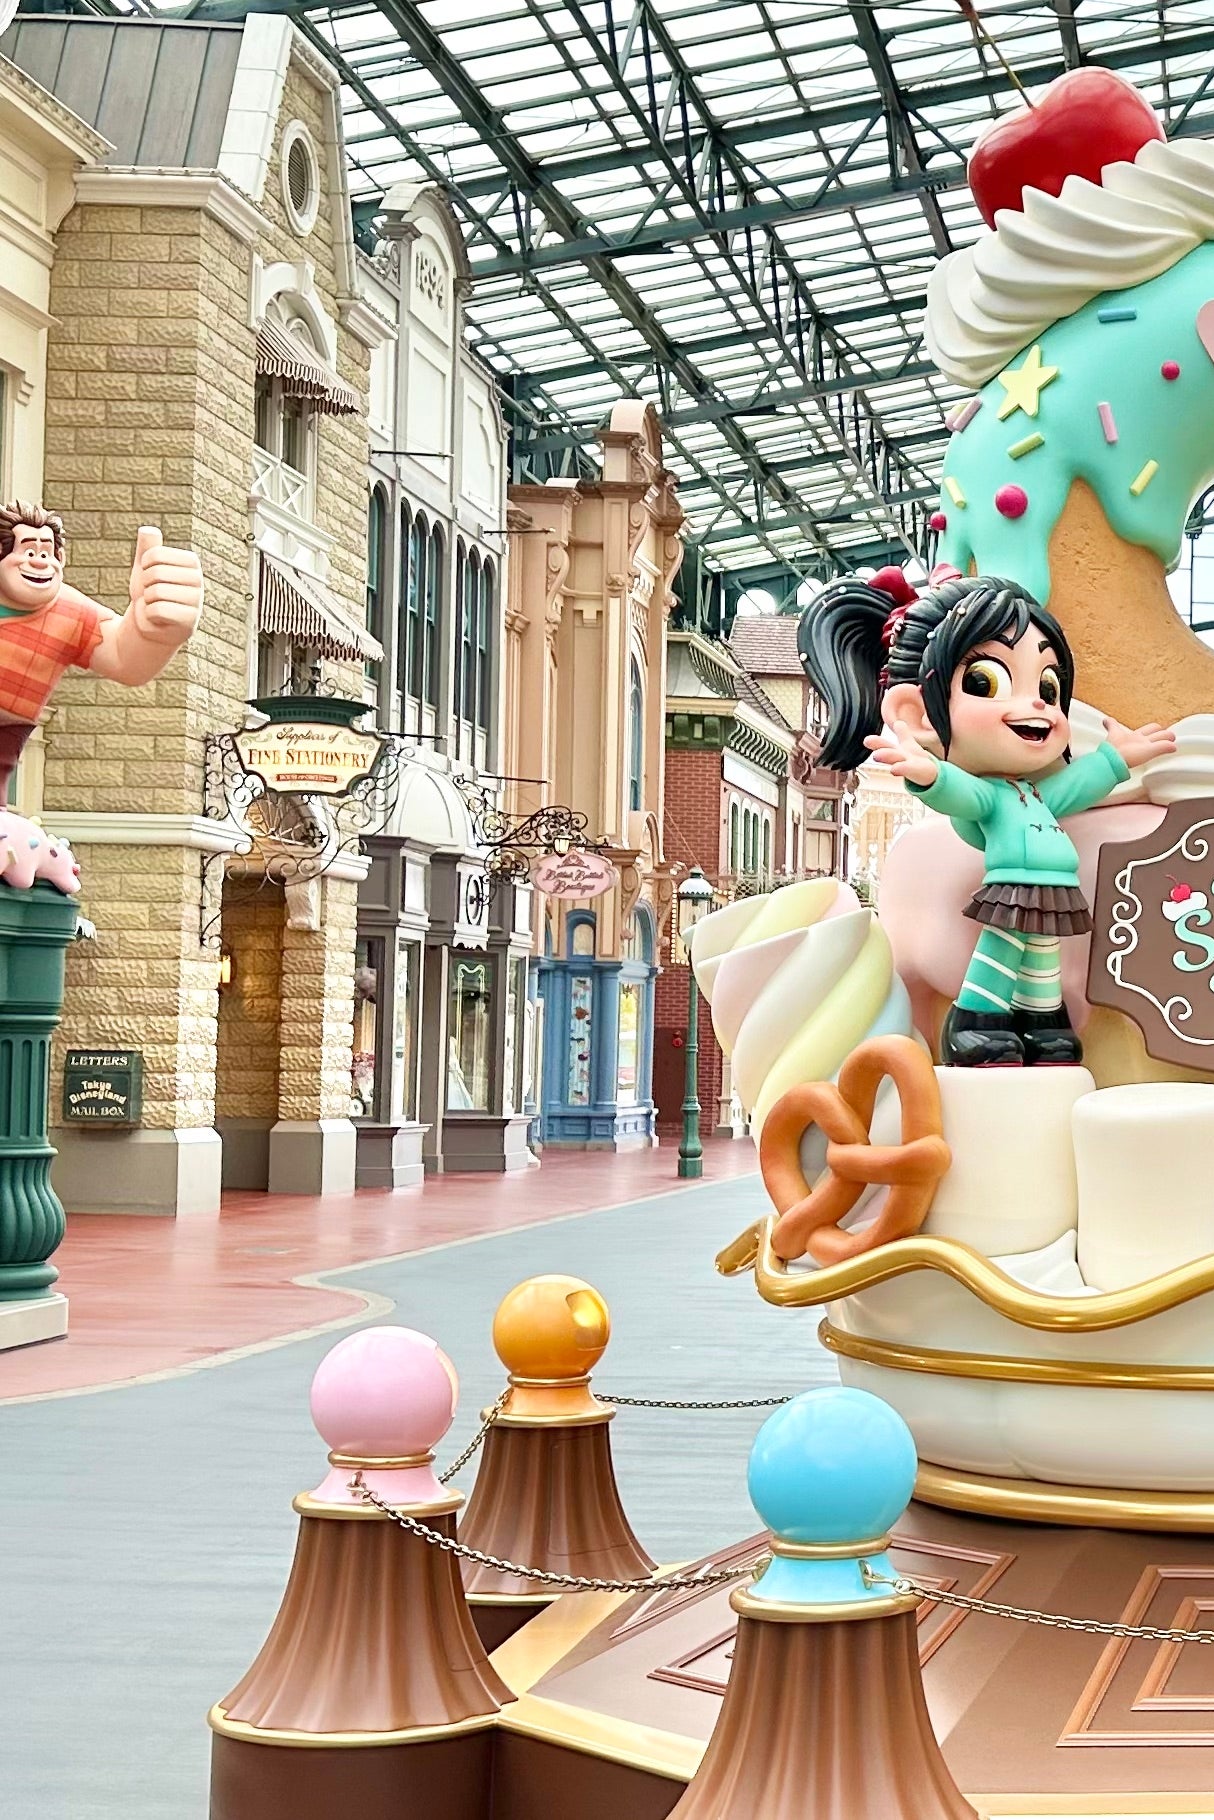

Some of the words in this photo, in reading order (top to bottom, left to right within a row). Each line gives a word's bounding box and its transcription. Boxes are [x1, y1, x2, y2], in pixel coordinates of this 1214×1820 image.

[328, 731, 343, 743] of
[248, 748, 281, 765] FINE
[286, 748, 370, 769] STATIONERY
[70, 1056, 128, 1066] LETTERS
[81, 1080, 112, 1091] Tokyo
[69, 1090, 127, 1105] Disneyland
[70, 1106, 99, 1116] MAIL
[100, 1106, 125, 1116] BOX
